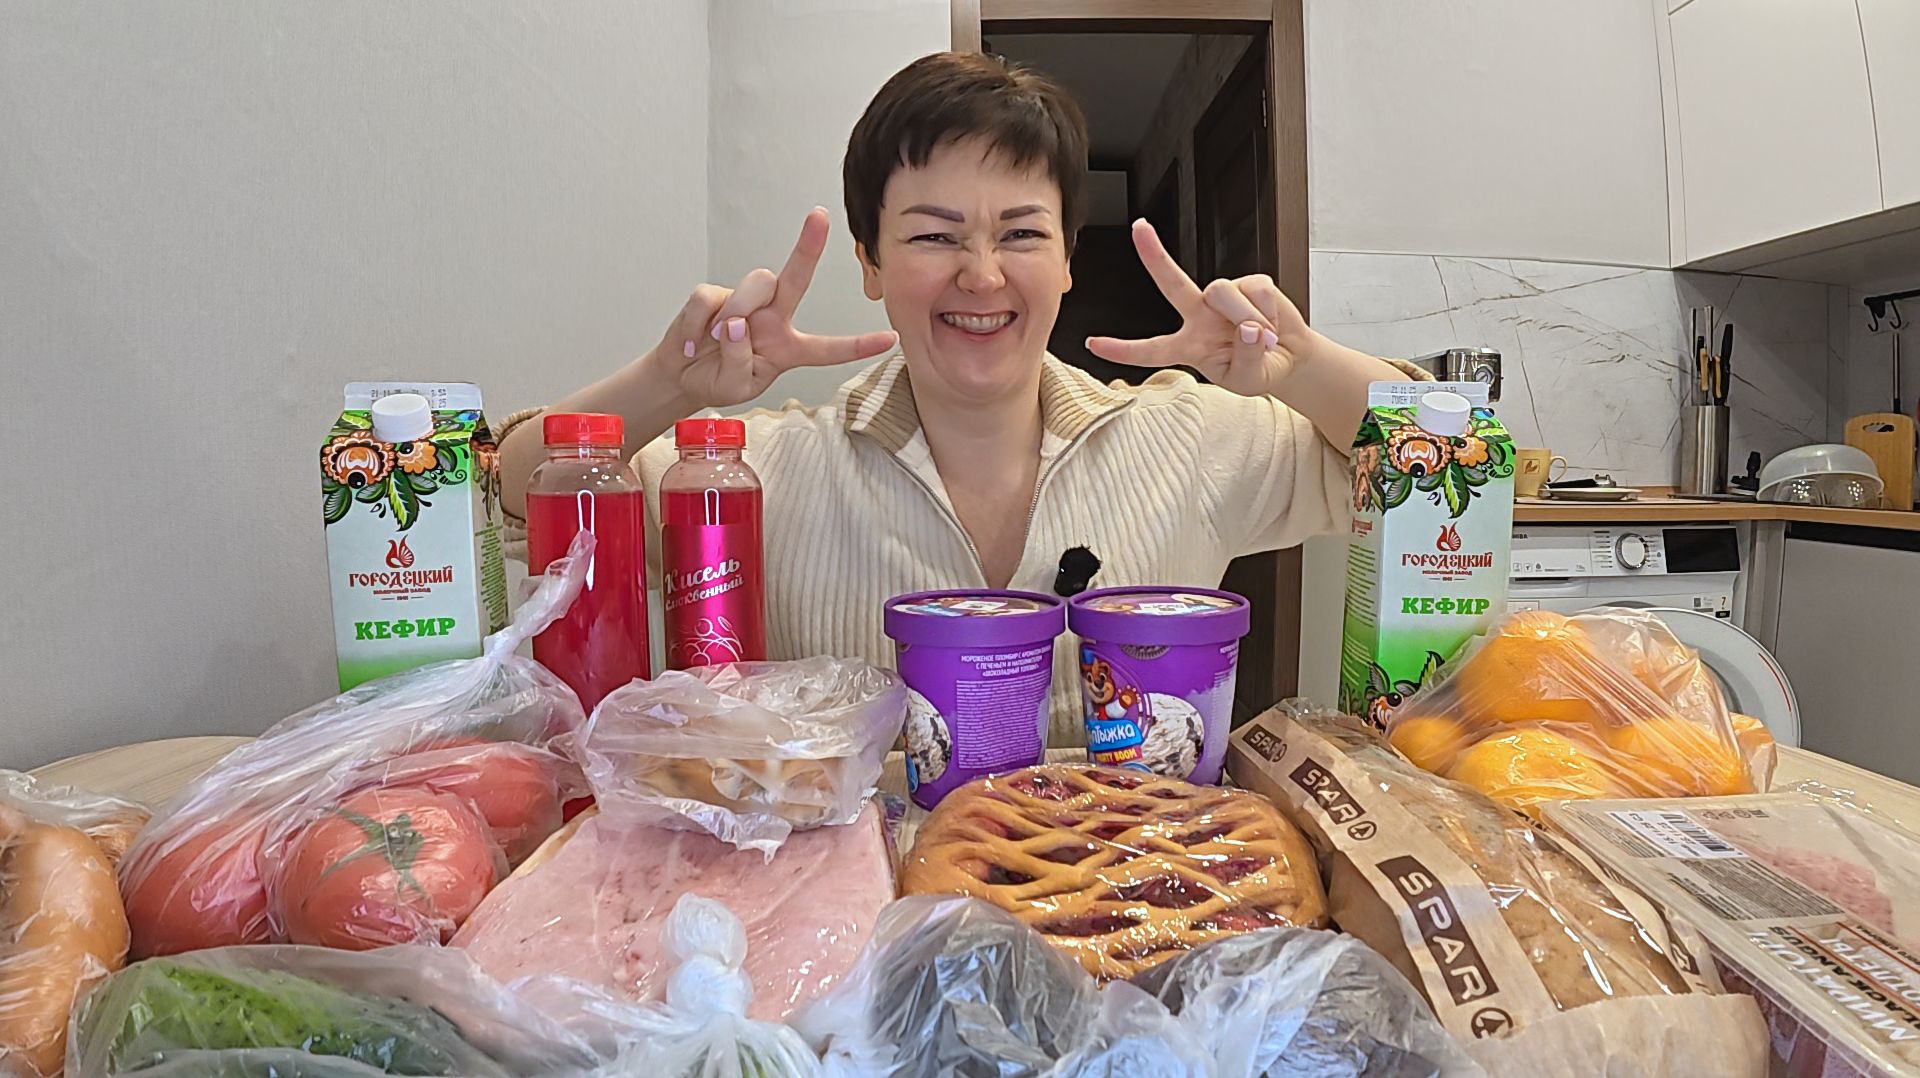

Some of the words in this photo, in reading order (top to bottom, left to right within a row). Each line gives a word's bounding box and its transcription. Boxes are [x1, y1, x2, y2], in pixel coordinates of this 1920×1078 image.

[349, 565, 453, 588] ГОРОДЕЦКИЙ
[665, 559, 740, 593] Кисель
[1401, 551, 1493, 570] ГОРОДЕЦКИЙ
[1401, 597, 1490, 615] КЕФИР
[355, 617, 455, 640] КЕФИР
[1302, 768, 1359, 822] SPAR
[1398, 871, 1488, 1000] SPAR
[1768, 926, 1854, 978] ANGUS
[1746, 930, 1920, 1041] МИРАТОРГ
[1819, 938, 1920, 1007] ОТЛЕТЫ
